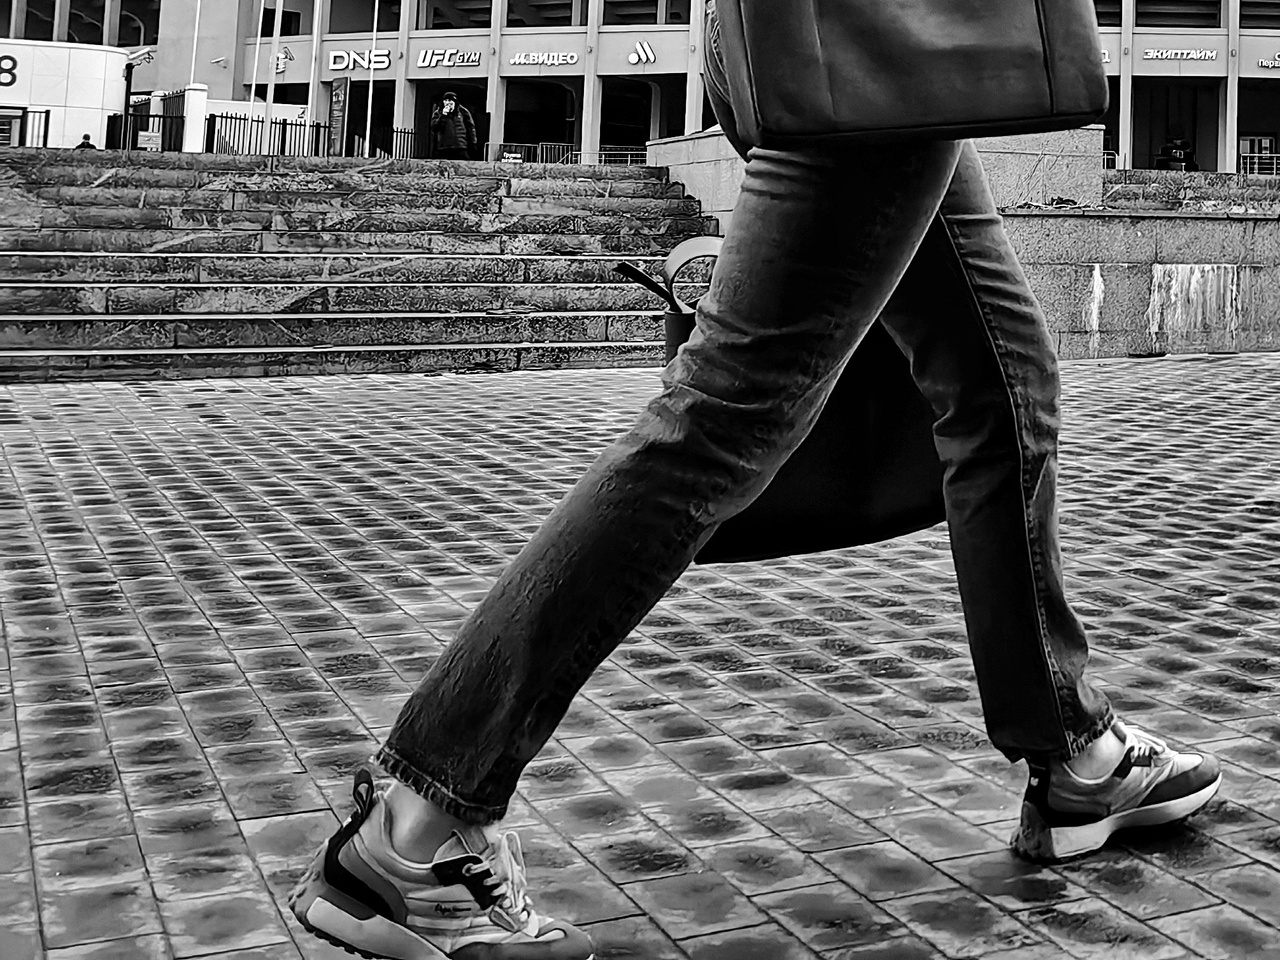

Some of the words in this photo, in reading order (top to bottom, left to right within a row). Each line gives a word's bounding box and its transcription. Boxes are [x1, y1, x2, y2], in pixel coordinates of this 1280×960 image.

[328, 49, 392, 70] DNS
[416, 48, 459, 68] UFC
[455, 51, 481, 66] GYM
